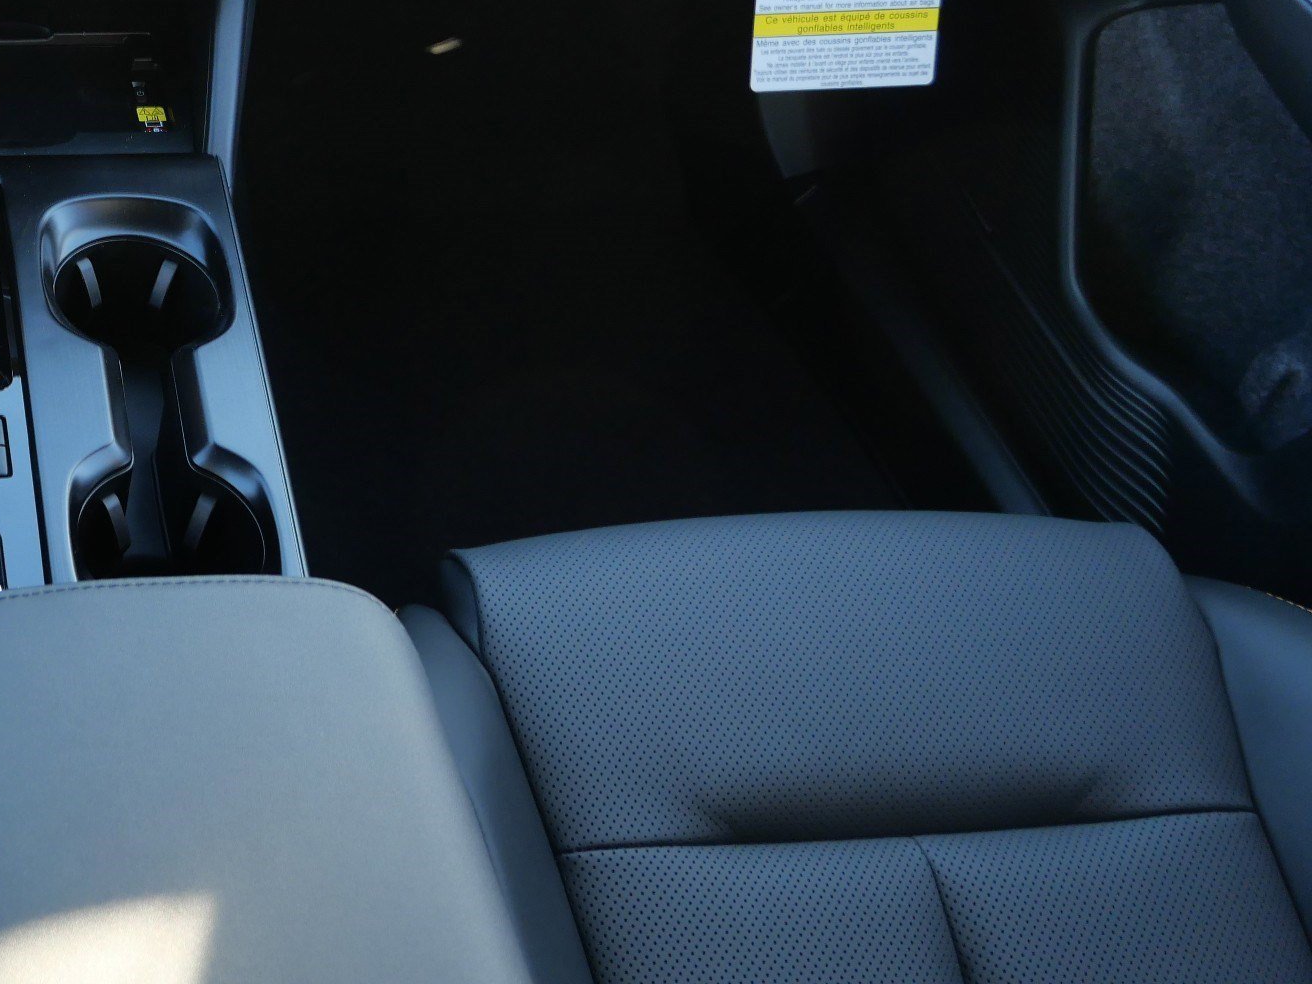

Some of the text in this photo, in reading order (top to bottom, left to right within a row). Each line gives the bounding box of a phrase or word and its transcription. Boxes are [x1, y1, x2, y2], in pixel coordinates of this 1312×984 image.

[765, 10, 929, 25] Ce véhicule est équipé de coussins
[797, 21, 895, 35] gonflables intelligents
[802, 38, 816, 46] des
